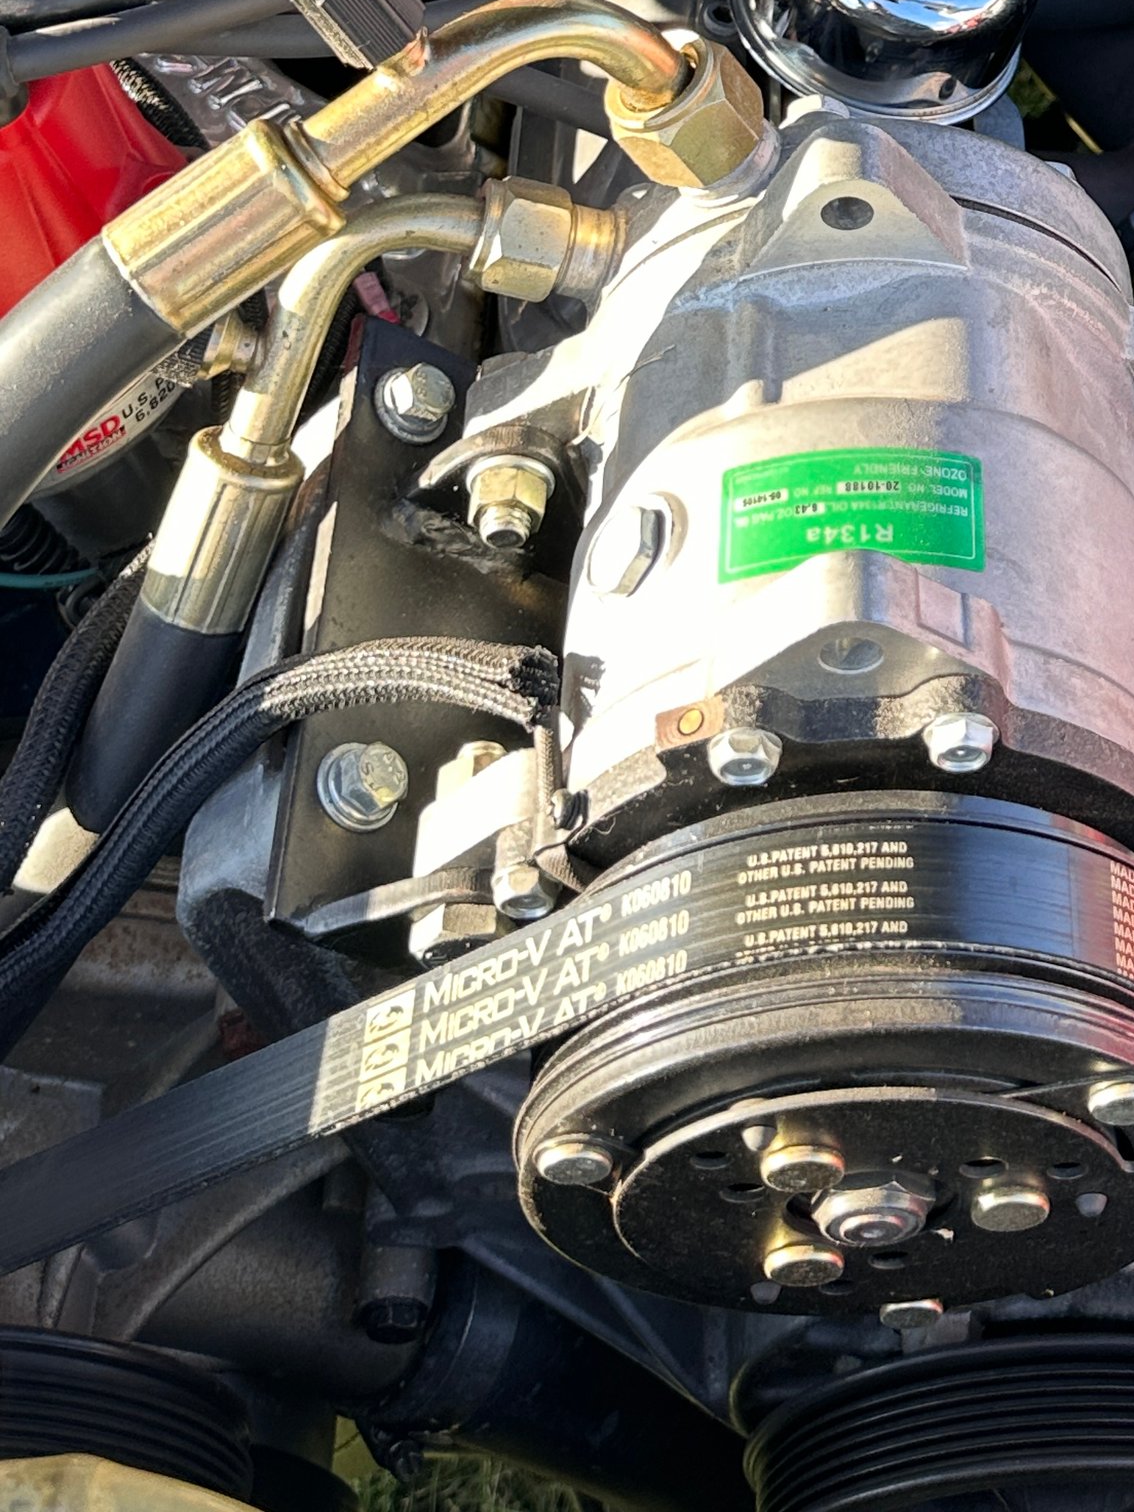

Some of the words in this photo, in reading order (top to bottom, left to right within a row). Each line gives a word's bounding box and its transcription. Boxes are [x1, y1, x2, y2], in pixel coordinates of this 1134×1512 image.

[60, 415, 121, 461] MSD
[853, 463, 919, 477] FRIENDLY
[924, 465, 968, 481] OZONE
[931, 483, 968, 499] MODEL
[806, 523, 894, 544] R134a
[881, 841, 908, 854] AND
[738, 866, 779, 885] OTHER
[809, 857, 858, 874] PATENT
[860, 856, 915, 869] PENDING
[881, 880, 908, 893] AND
[735, 906, 778, 926] OTHER
[808, 897, 858, 914] PATENT
[860, 896, 915, 909] PENDING
[881, 920, 908, 933] AND
[423, 929, 552, 1013] MICRO-V
[620, 870, 692, 918] K060810
[418, 967, 548, 1053] MICRO-V
[618, 909, 690, 957] K060810
